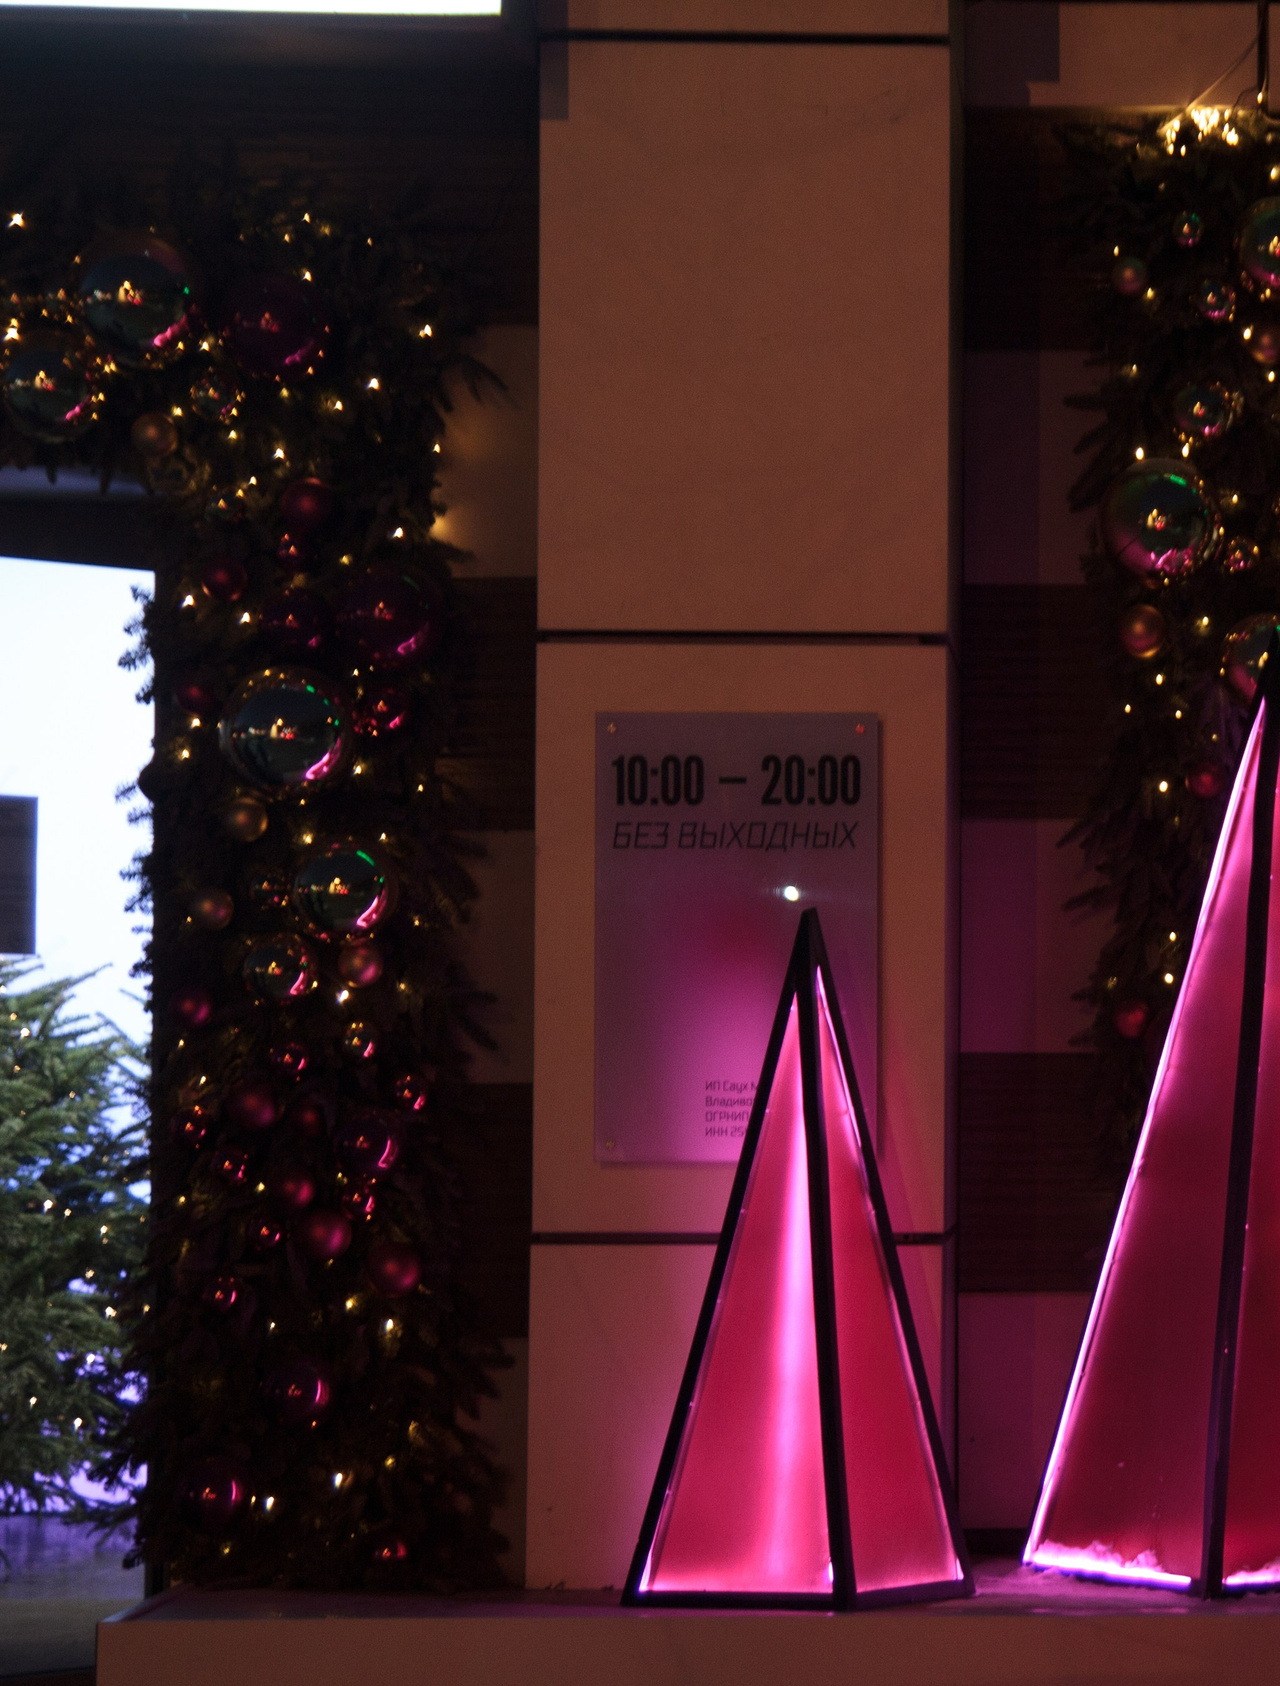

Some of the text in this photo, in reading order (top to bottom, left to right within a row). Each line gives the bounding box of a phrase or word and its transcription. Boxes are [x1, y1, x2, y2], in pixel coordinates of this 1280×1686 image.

[611, 753, 704, 806] 10:00
[761, 753, 862, 806] 20:00
[612, 821, 859, 852] БЕЗ ВЫХОДНЫХ
[705, 1080, 720, 1091] ИП
[705, 1110, 749, 1122] ОГРНИП
[705, 1126, 728, 1137] ИНН
